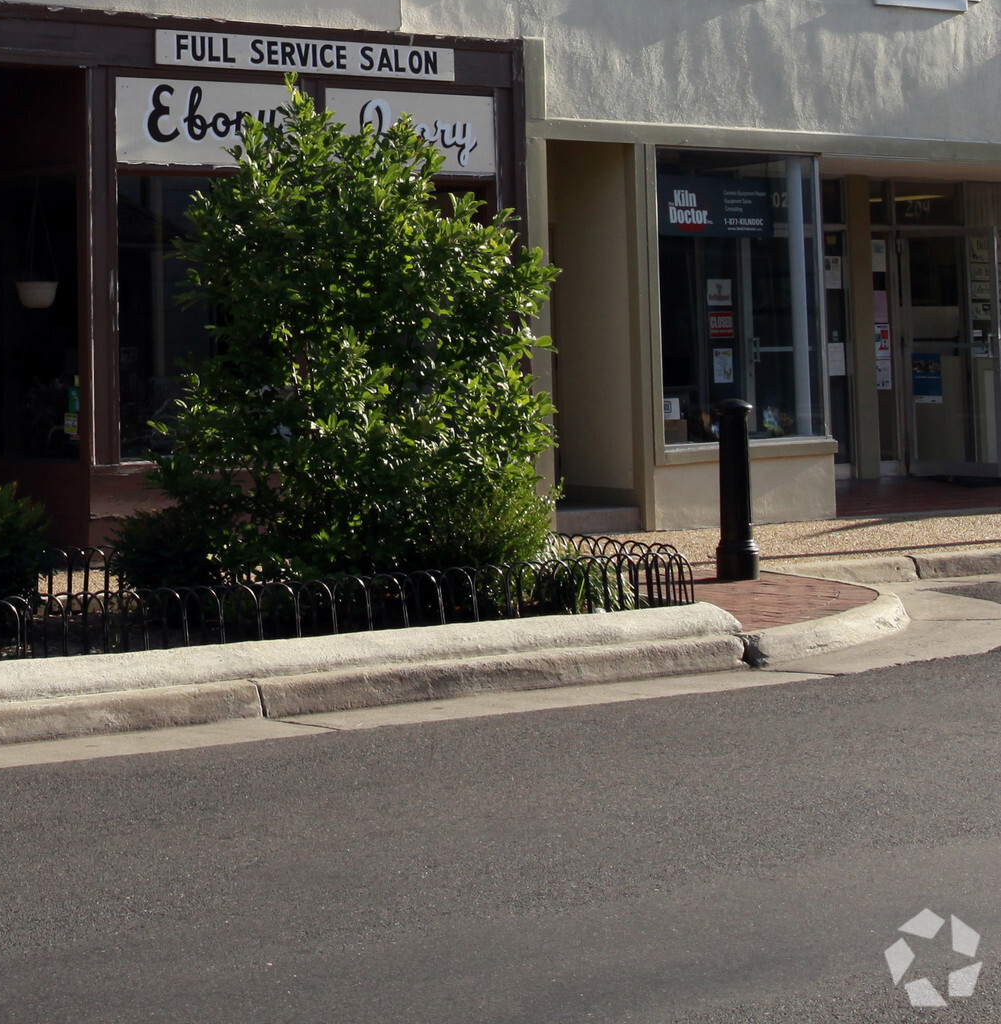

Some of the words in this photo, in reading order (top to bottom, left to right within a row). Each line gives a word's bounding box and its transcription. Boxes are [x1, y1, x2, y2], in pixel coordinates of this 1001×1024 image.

[175, 34, 236, 63] FULL
[250, 39, 347, 70] SERVICE
[360, 46, 438, 75] SALON
[673, 189, 697, 207] Kiln
[669, 206, 708, 225] Doctor
[904, 200, 930, 218] 204
[724, 217, 764, 226] 1-877-KILNDOC
[710, 316, 733, 328] CLOSED
